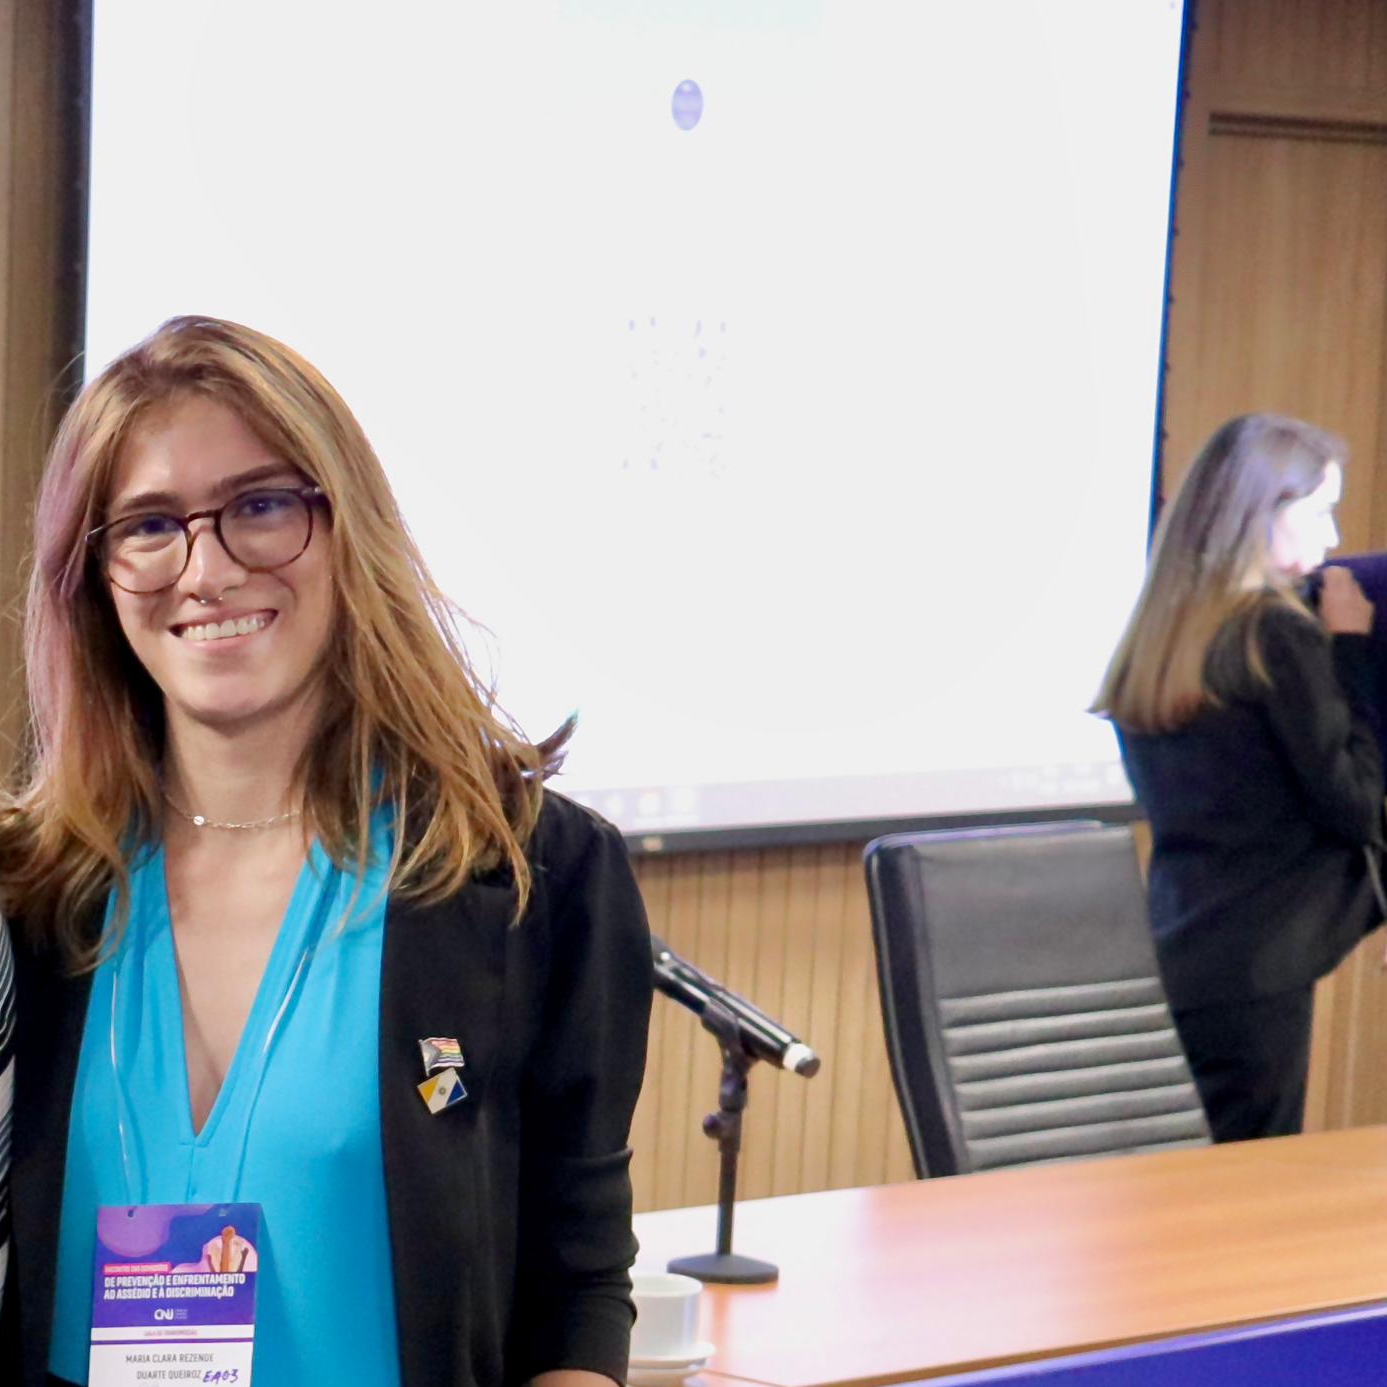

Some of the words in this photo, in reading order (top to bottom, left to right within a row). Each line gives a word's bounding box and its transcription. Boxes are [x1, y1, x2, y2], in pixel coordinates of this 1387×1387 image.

[104, 1276, 115, 1287] DE
[116, 1274, 164, 1288] PREVENÇÃO
[166, 1275, 171, 1285] E
[173, 1274, 245, 1286] ENFRENTAMENTO
[104, 1288, 115, 1299] AO
[116, 1286, 150, 1299] ASSÉDIO
[152, 1288, 157, 1298] E
[166, 1284, 234, 1299] DISCRIMINAÇÃO
[126, 1354, 151, 1364] MARIA
[152, 1354, 177, 1363] CLARA
[179, 1353, 213, 1363] REZENDE
[137, 1370, 166, 1380] DUARTE
[168, 1370, 201, 1380] QUEIROZ
